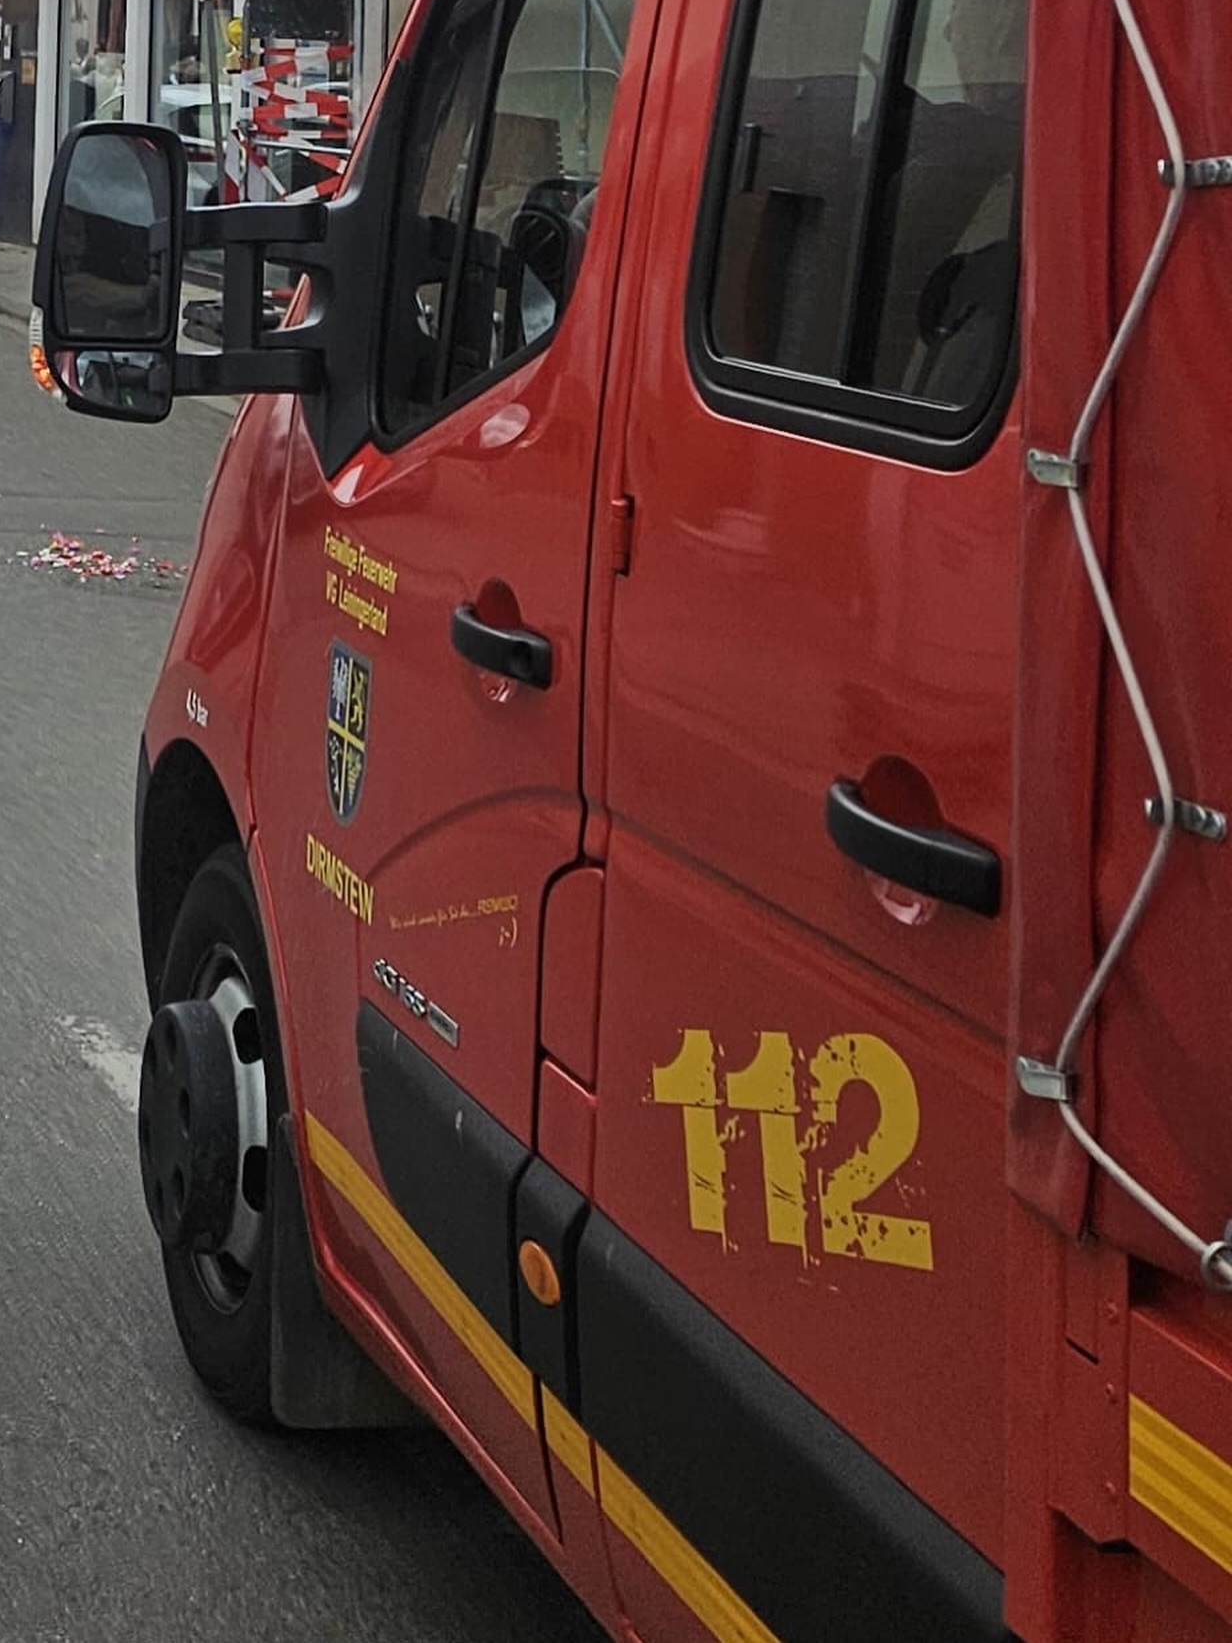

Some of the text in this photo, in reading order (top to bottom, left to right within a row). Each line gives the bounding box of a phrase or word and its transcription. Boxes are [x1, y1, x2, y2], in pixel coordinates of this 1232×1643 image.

[326, 569, 338, 605] VG
[357, 544, 398, 595] Feuerwehr
[306, 832, 375, 928] DIRMSTEIN
[651, 1028, 935, 1272] 112
